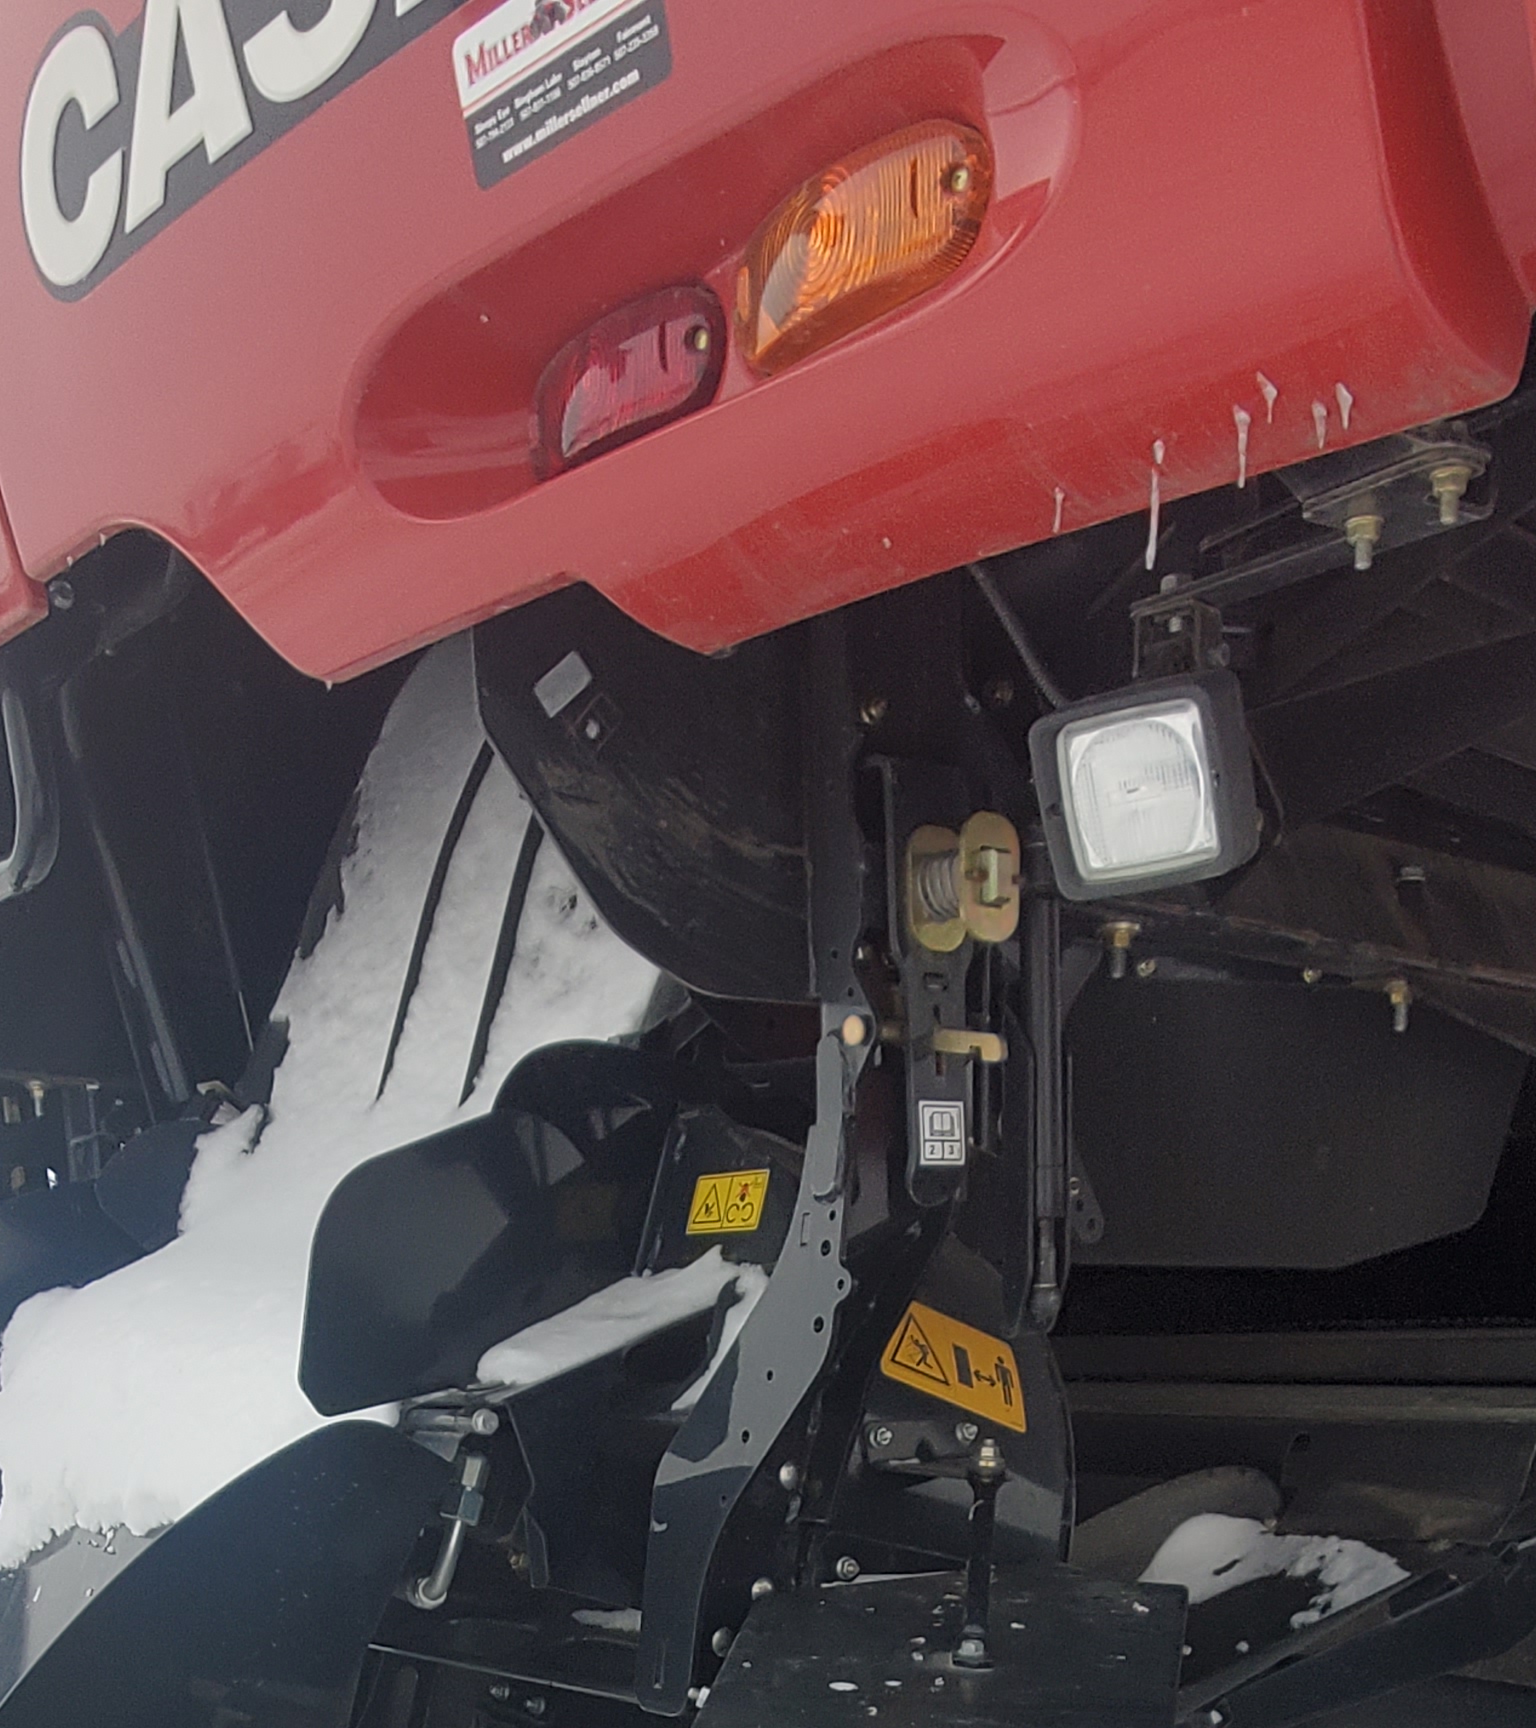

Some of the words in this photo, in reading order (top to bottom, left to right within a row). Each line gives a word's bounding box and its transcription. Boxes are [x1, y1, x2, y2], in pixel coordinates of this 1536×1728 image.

[21, 0, 424, 286] CA
[929, 1144, 936, 1155] 2
[948, 1144, 955, 1155] 3
